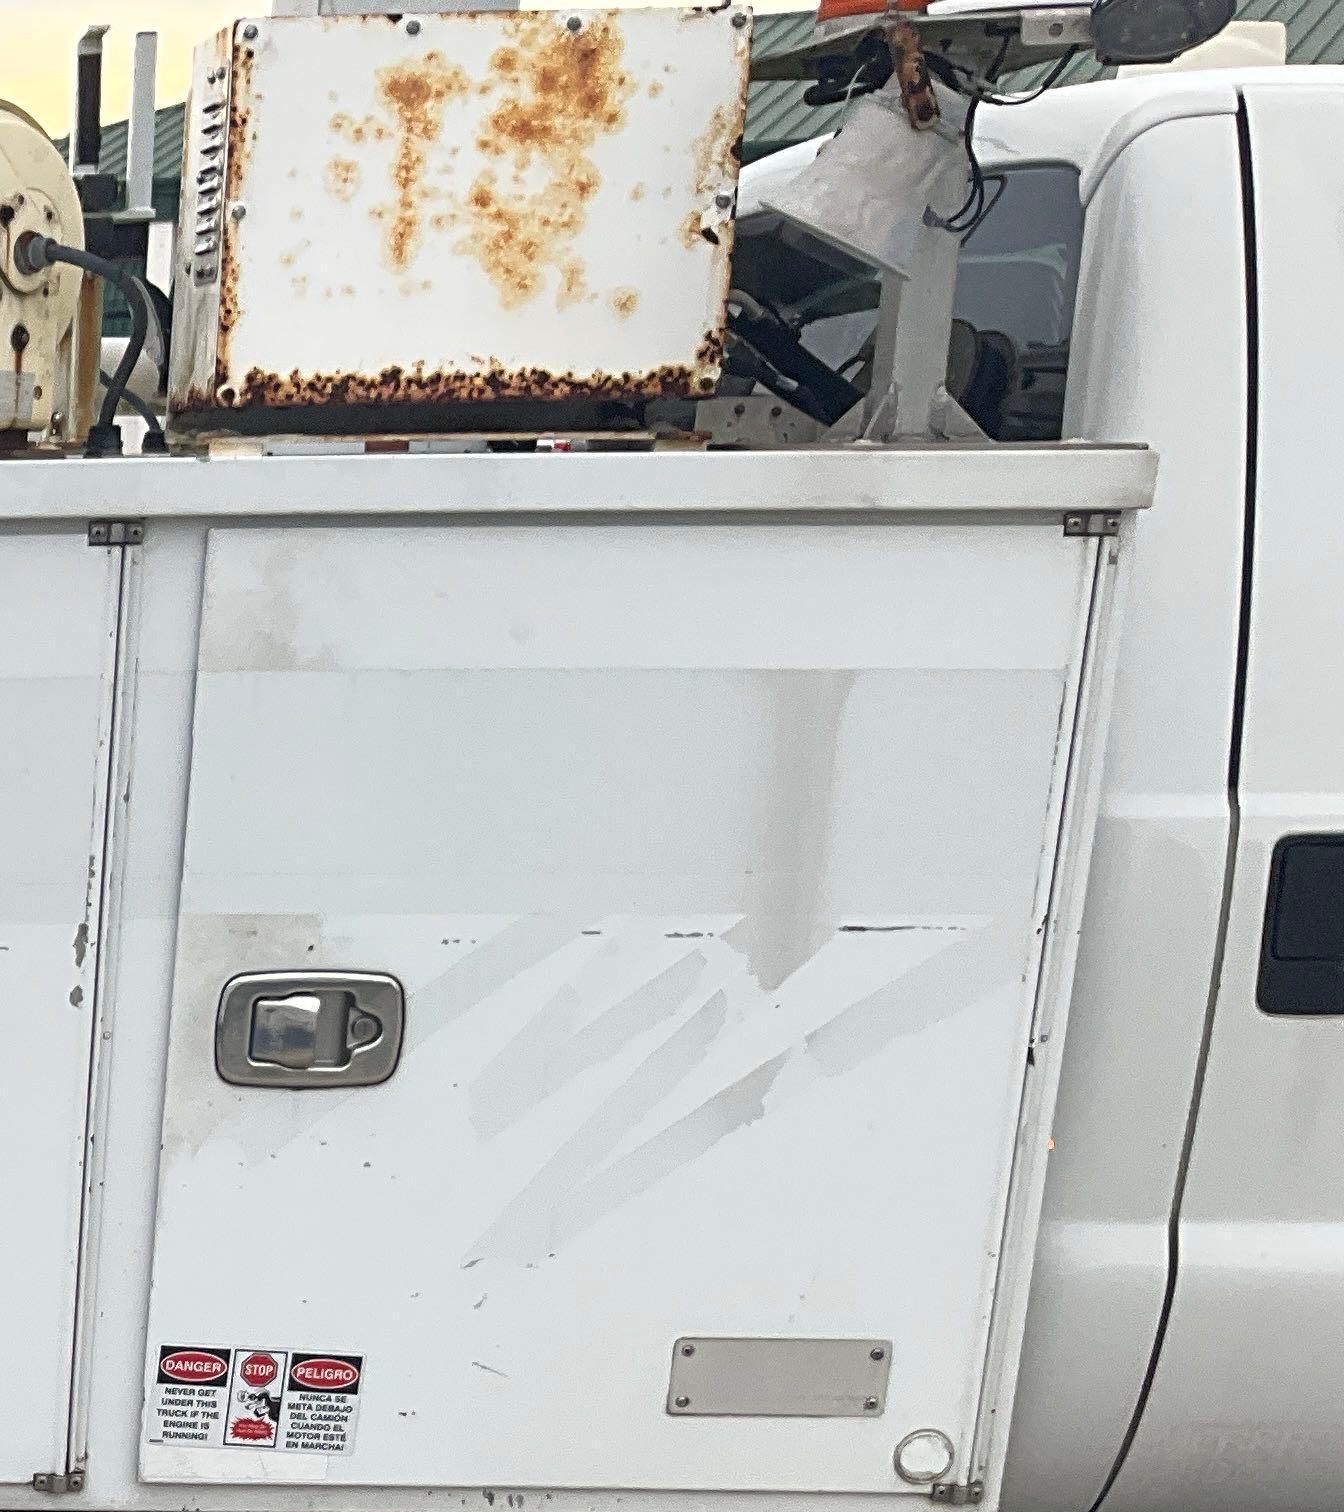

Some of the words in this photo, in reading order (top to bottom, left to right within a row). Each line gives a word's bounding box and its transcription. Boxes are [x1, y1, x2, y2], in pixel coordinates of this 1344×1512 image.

[165, 1359, 222, 1373] DANGER
[244, 1364, 273, 1376] STOP
[296, 1366, 353, 1381] PELIGRO
[164, 1387, 195, 1396] NEVER
[197, 1389, 217, 1397] GET
[161, 1398, 194, 1407] UNDER
[196, 1399, 217, 1408] THIS
[299, 1393, 332, 1402] NUNCA
[335, 1395, 347, 1403] SE
[287, 1402, 313, 1411] META
[315, 1404, 353, 1413] DEBAJO
[156, 1408, 188, 1417] TRUCK
[190, 1410, 199, 1418] IF
[201, 1411, 219, 1419] THE
[289, 1412, 308, 1420] DEL
[163, 1420, 198, 1429] ENGINE
[200, 1422, 210, 1430] IS
[290, 1422, 331, 1431] CUANDO
[333, 1424, 345, 1432] EL
[162, 1431, 208, 1440] RUNNING!
[286, 1431, 321, 1440] MOTOR
[301, 1441, 345, 1451] MARCHA!
